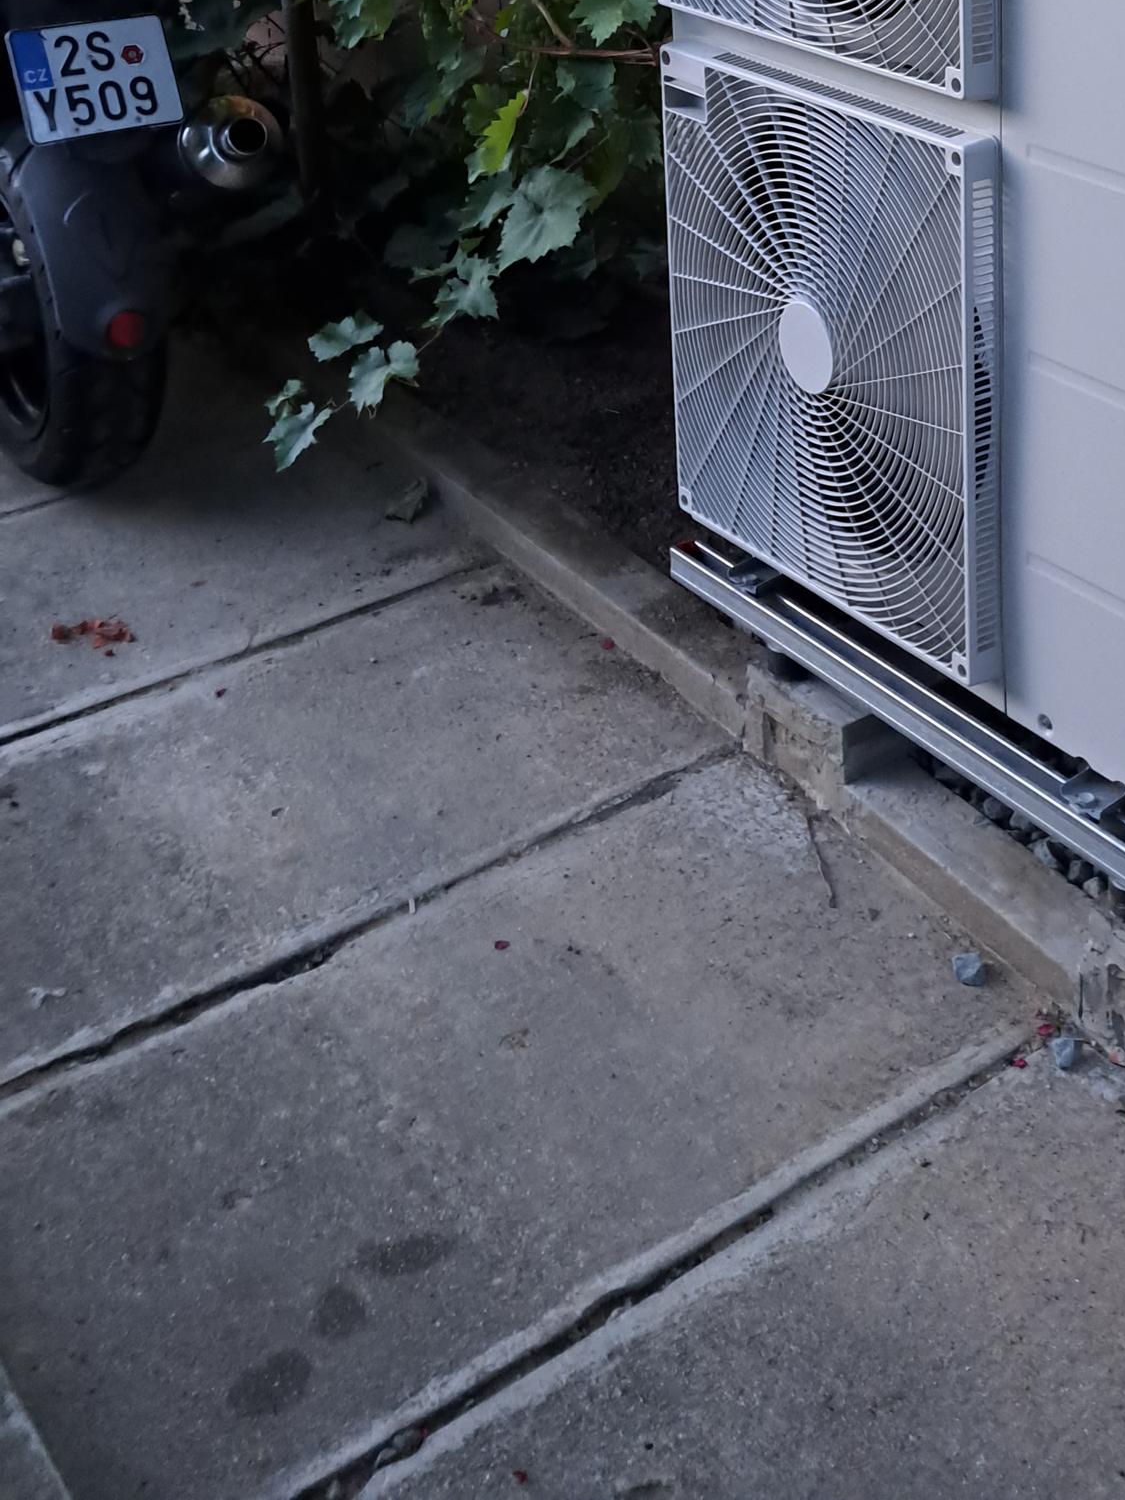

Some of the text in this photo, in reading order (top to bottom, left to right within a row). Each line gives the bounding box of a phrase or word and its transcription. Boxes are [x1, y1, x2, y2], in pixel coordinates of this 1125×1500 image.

[24, 68, 49, 83] CZ
[54, 31, 115, 77] 2S
[33, 76, 158, 132] Y509
